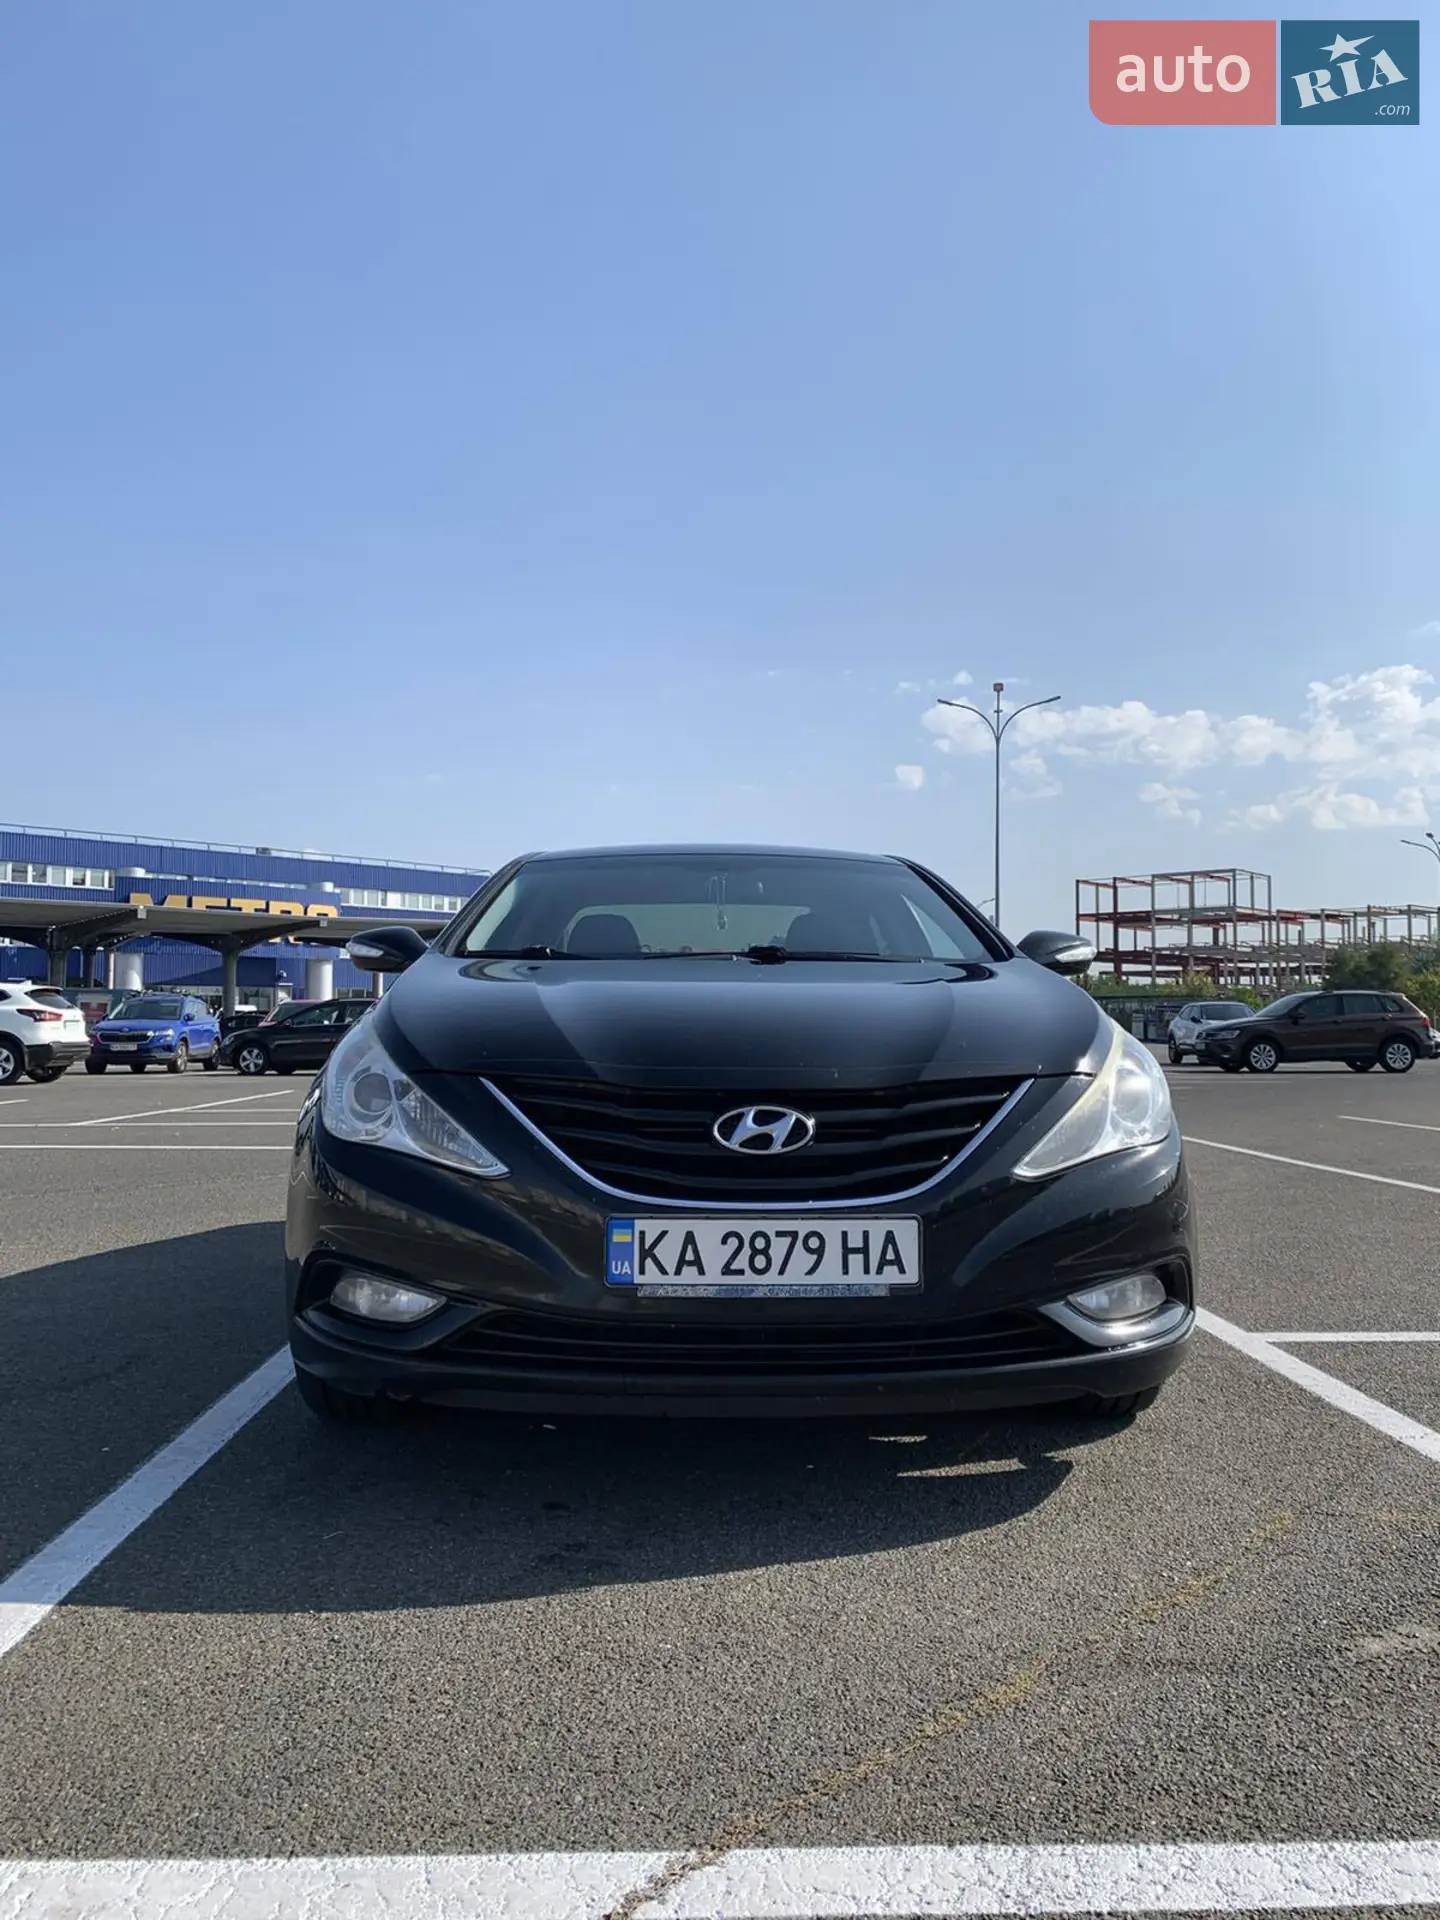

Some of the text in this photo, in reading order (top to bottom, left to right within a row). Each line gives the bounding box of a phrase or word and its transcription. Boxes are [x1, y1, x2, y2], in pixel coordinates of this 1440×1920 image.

[612, 1261, 632, 1275] UA
[638, 1229, 907, 1277] KA 2879 HA
